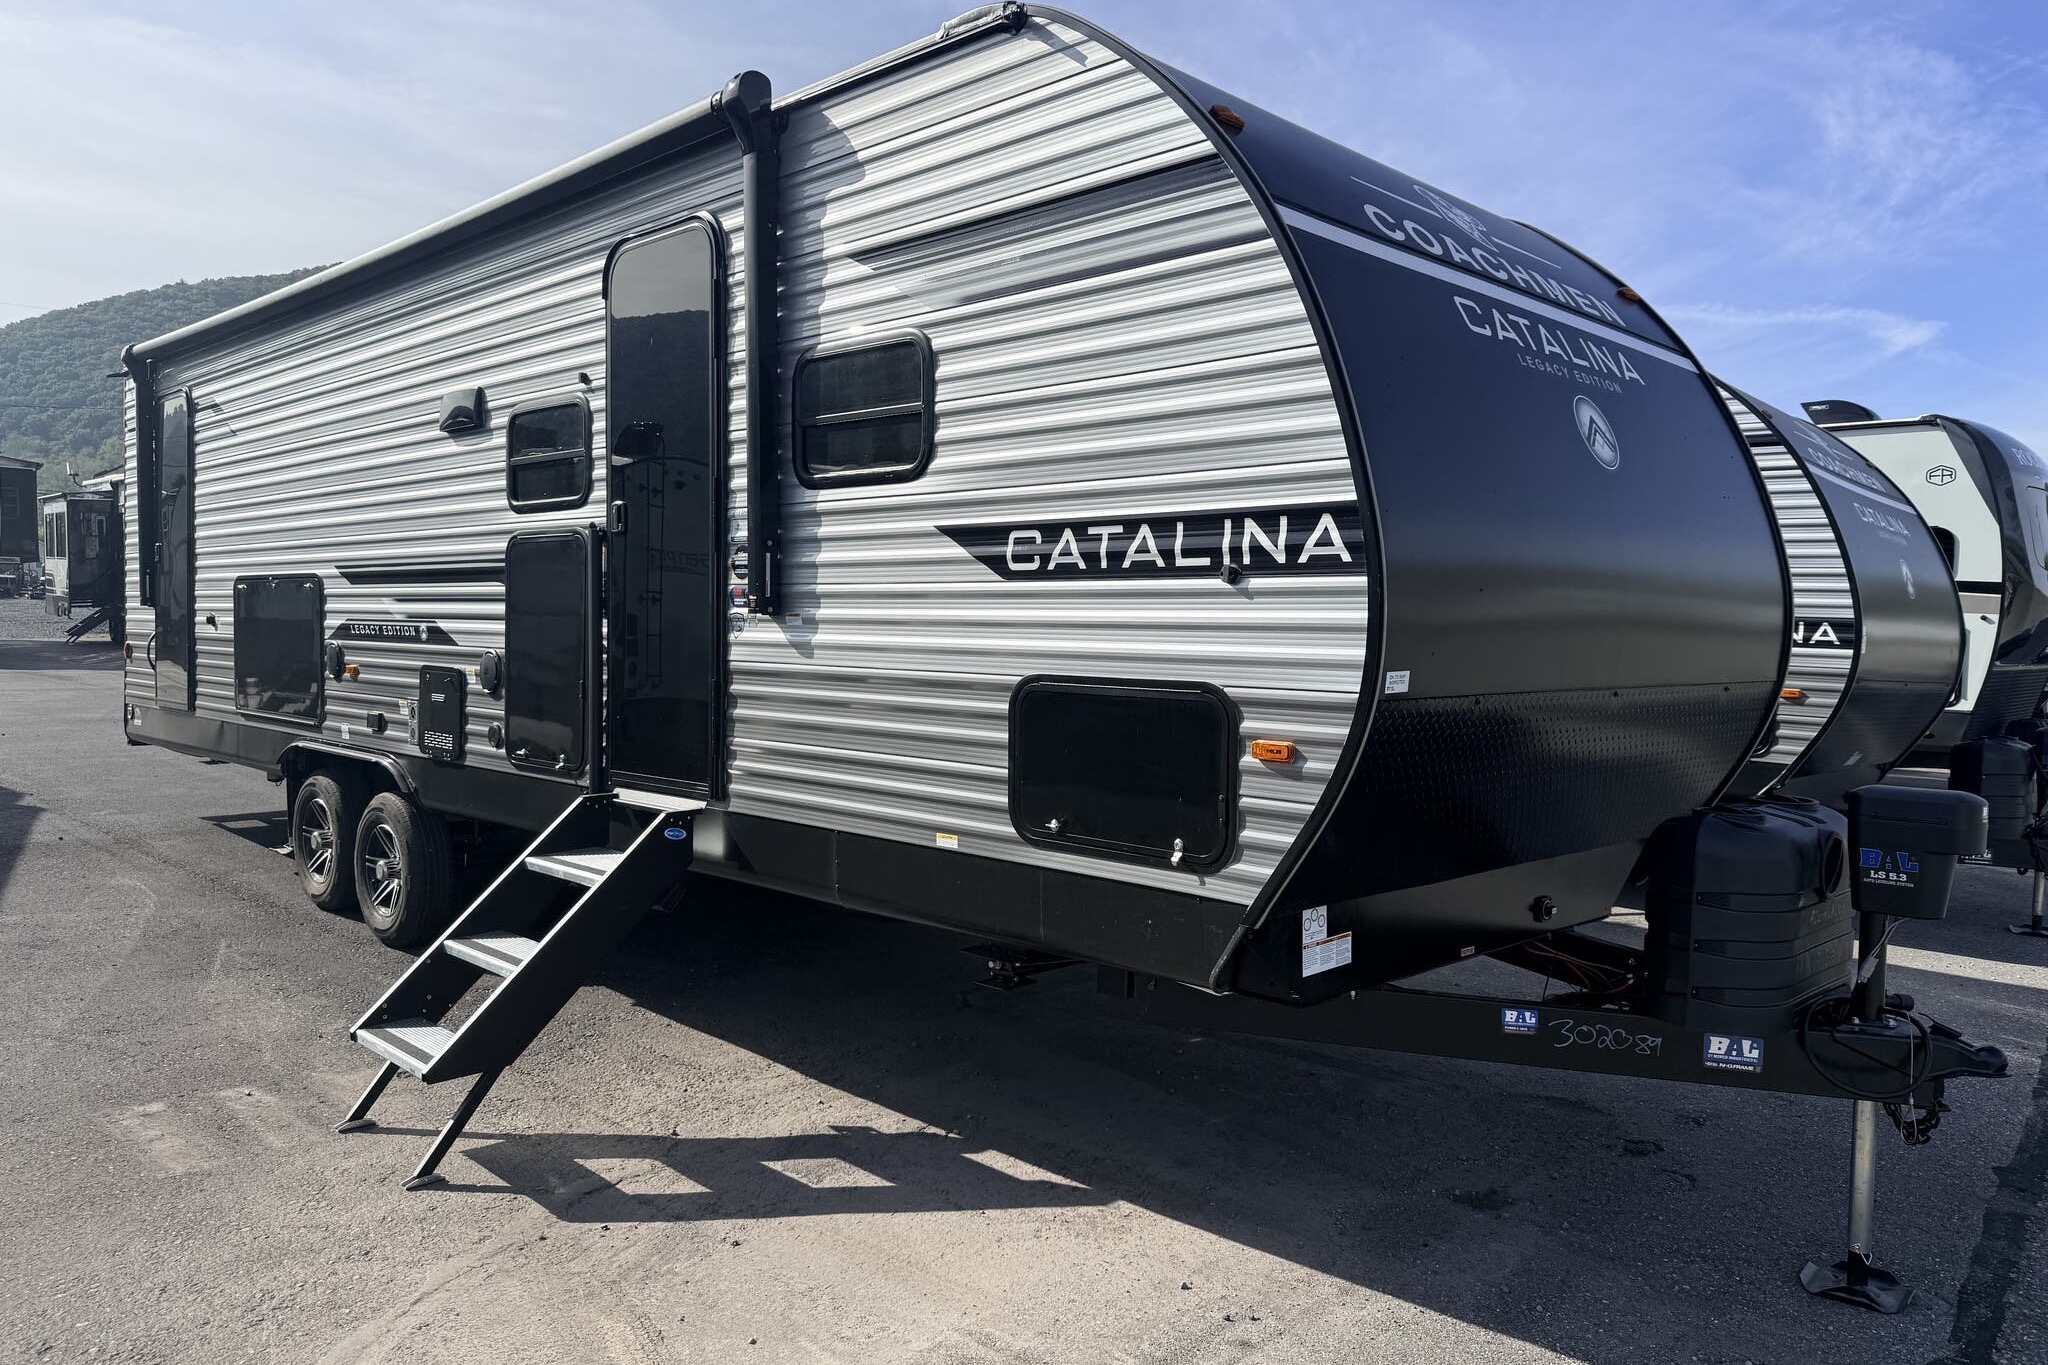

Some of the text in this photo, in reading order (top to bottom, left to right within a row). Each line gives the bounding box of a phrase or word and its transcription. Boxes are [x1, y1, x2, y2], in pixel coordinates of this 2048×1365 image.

[1363, 203, 1626, 328] COACHMEN
[1453, 295, 1646, 386] CATALINA
[1516, 352, 1622, 393] LEGACY EDITION
[1006, 512, 1352, 572] CATALINA
[349, 624, 416, 636] LEGACY EDITION
[1859, 847, 1919, 873] BAL
[1870, 870, 1907, 882] LS 5.3
[1504, 1010, 1537, 1024] BAL
[1548, 1018, 1664, 1057] 302089
[1708, 1035, 1760, 1059] BAL
